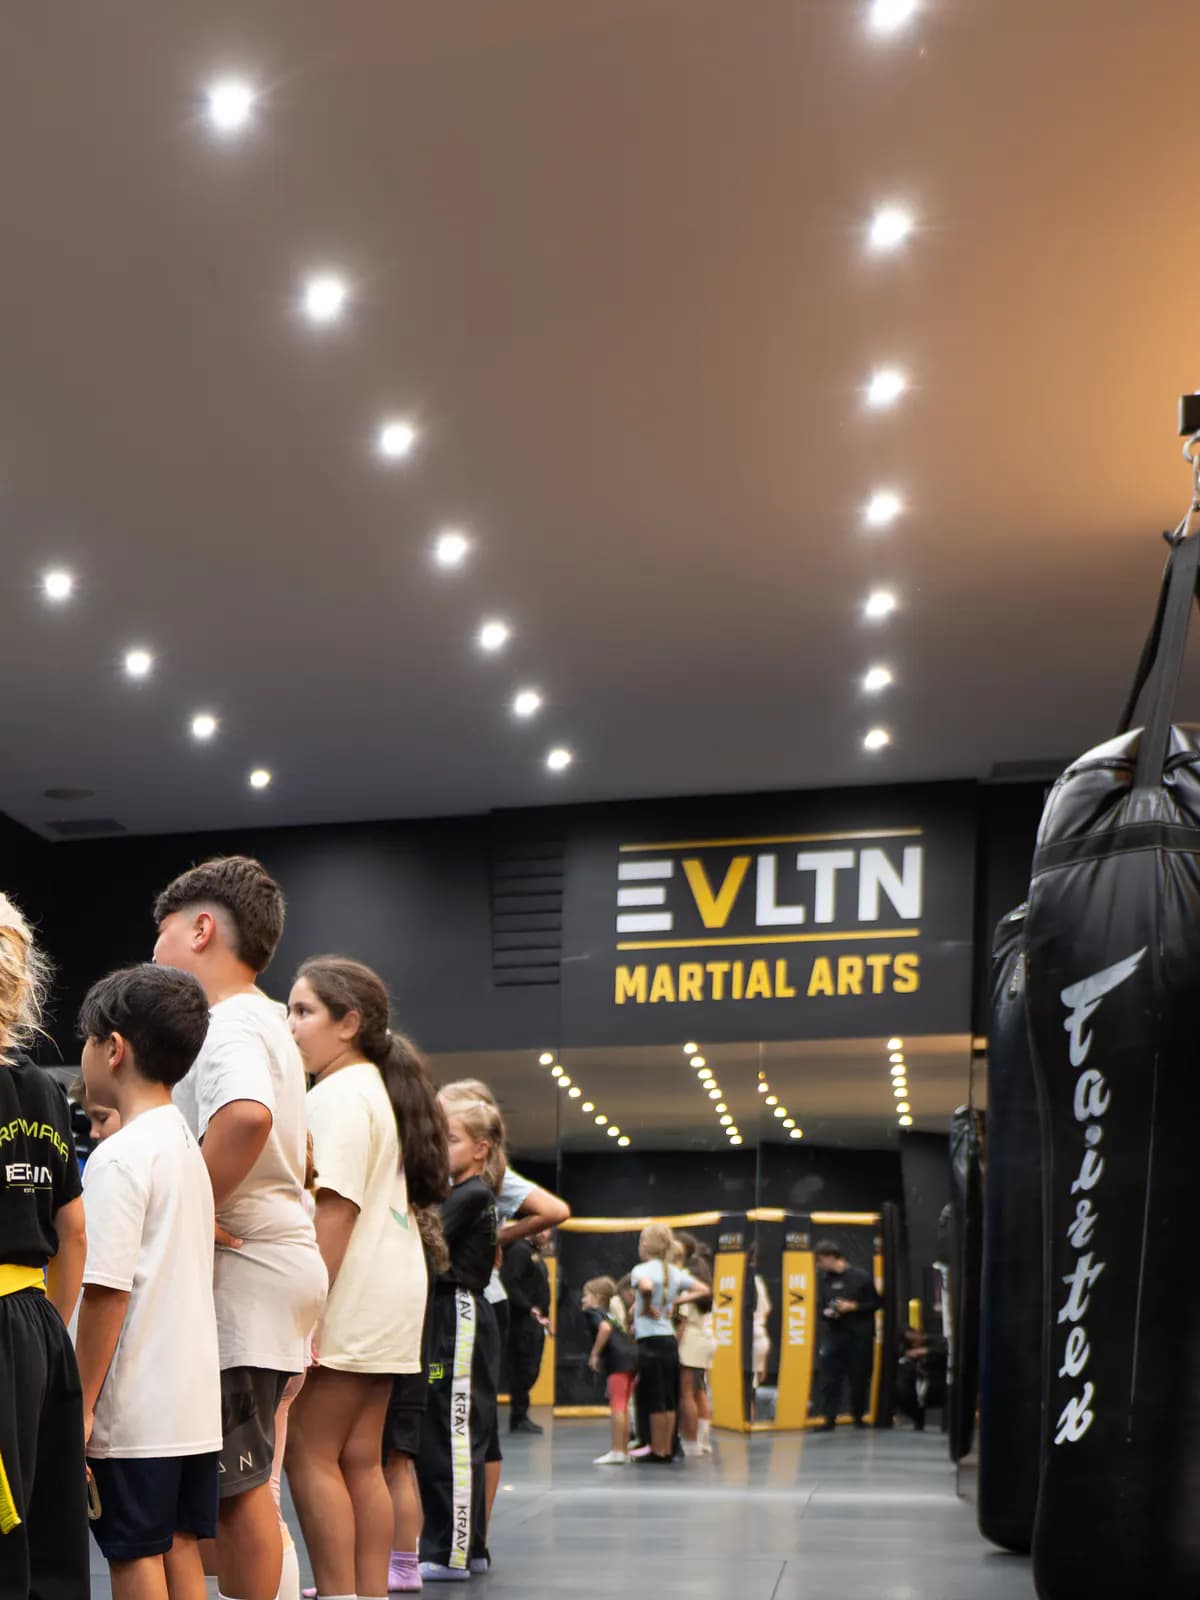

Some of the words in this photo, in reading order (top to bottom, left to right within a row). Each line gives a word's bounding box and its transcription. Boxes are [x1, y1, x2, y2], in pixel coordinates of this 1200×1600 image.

[616, 845, 923, 933] EVLTN
[614, 962, 797, 1005] MARTIAL
[807, 951, 920, 998] ARTS
